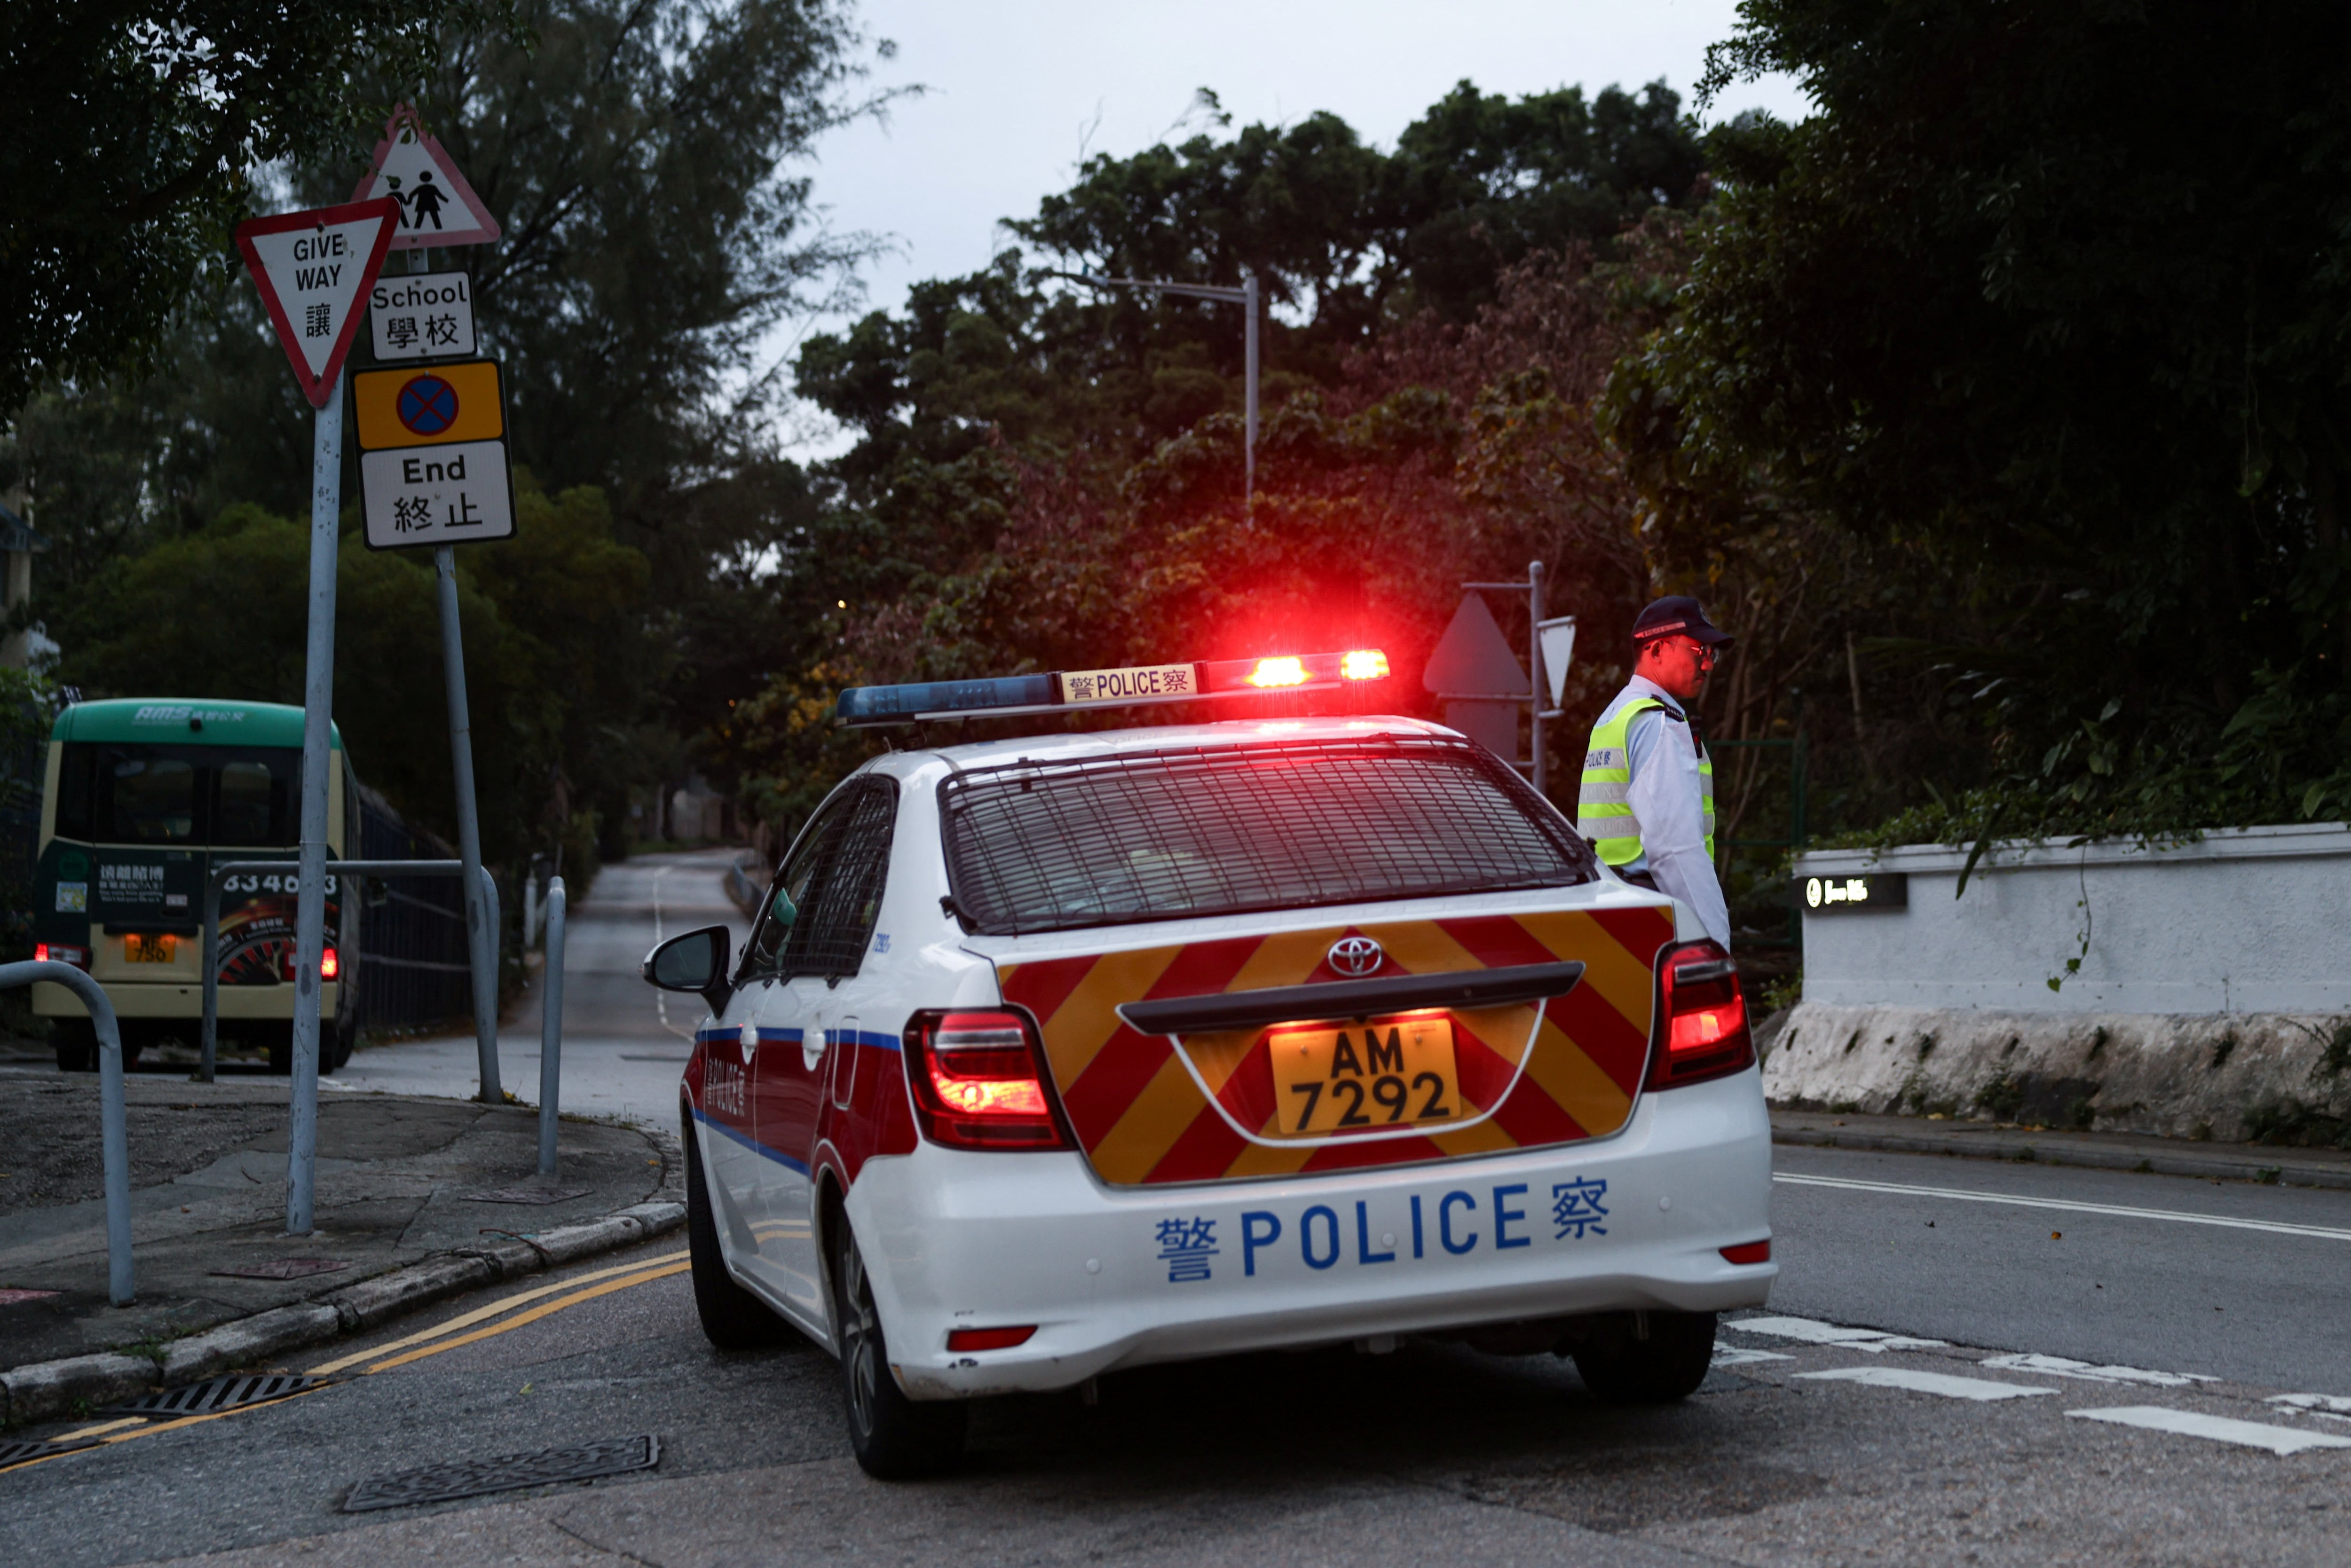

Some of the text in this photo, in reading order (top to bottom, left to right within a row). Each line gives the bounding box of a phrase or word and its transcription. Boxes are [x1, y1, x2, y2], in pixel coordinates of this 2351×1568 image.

[294, 234, 344, 261] GIVE
[295, 264, 341, 291] WAY
[372, 281, 466, 309] School
[306, 303, 331, 338] 讓
[387, 313, 458, 348] 學校
[402, 454, 466, 484] End
[394, 492, 482, 533] 終止
[1097, 670, 1160, 697] POLICE
[1330, 1027, 1404, 1079] AM
[713, 1057, 738, 1116] POLICE
[1291, 1072, 1450, 1130] 7292
[1155, 1175, 1609, 1283] 警 POLICE 察
